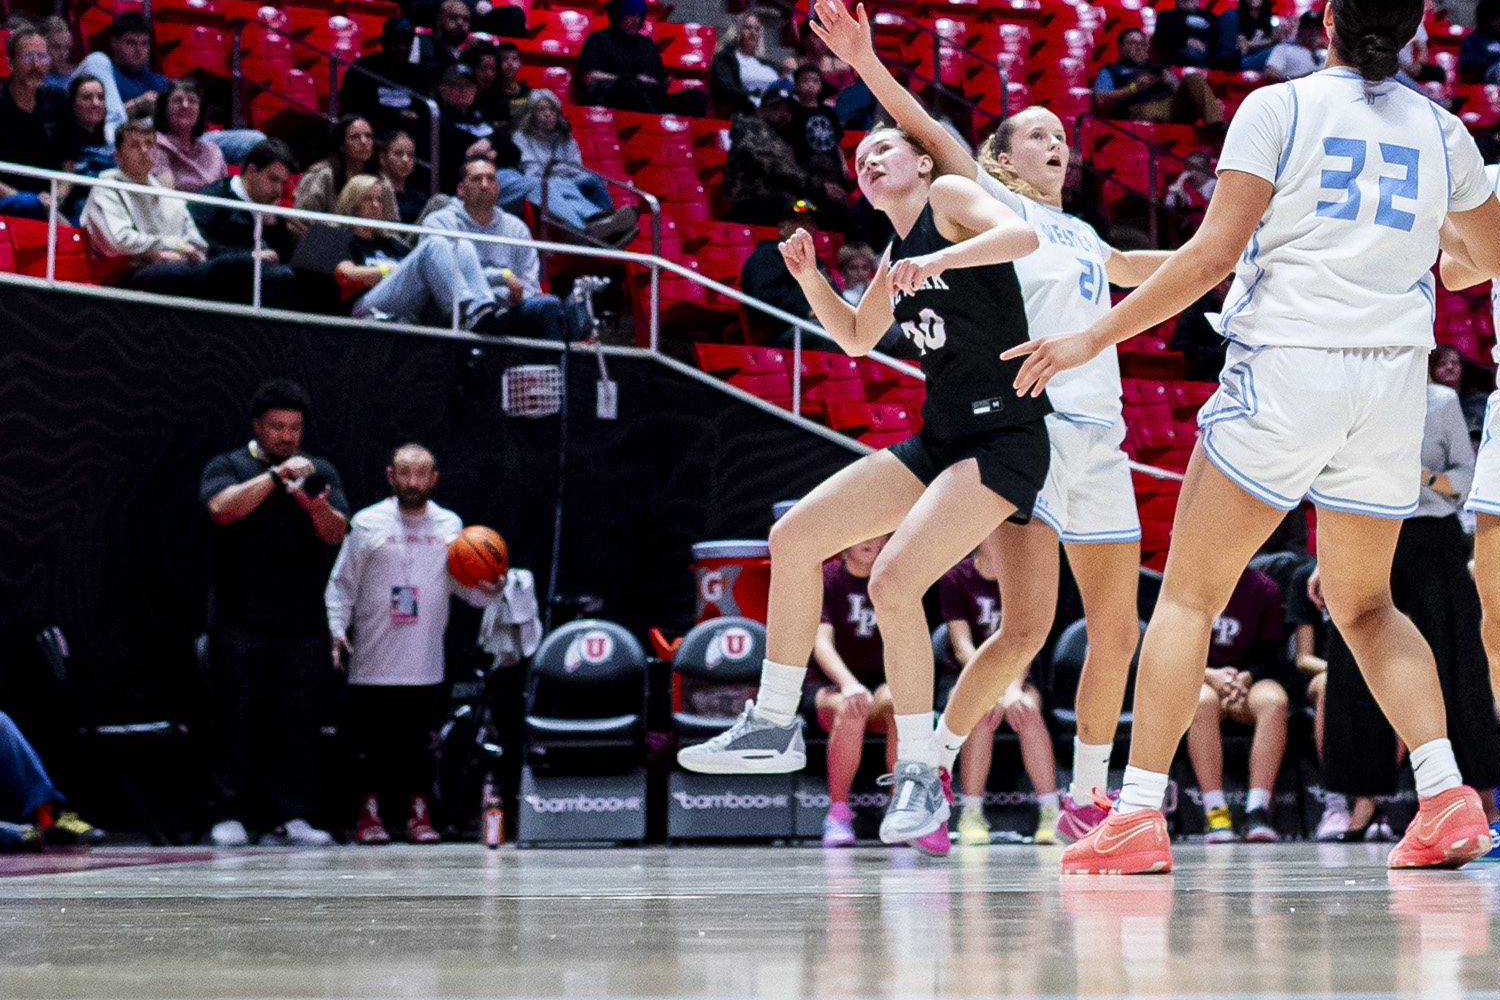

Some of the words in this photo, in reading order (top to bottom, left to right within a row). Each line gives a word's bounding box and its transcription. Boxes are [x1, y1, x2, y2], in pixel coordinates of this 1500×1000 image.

[1315, 136, 1420, 233] 32
[700, 571, 723, 601] G
[586, 638, 606, 658] U
[726, 635, 746, 655] U
